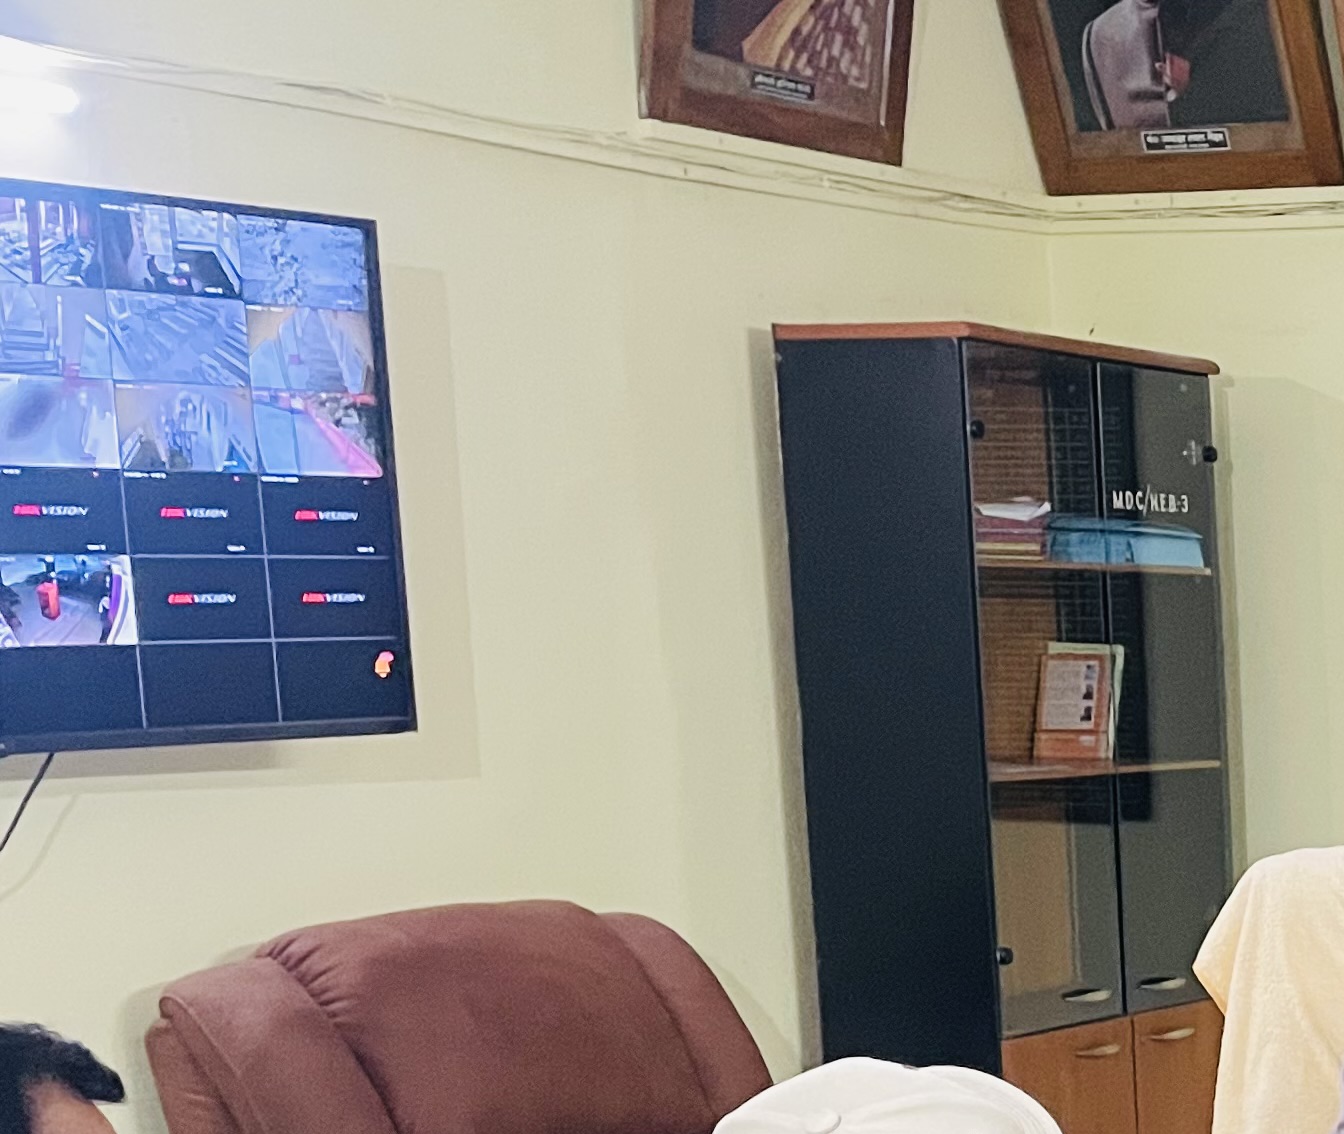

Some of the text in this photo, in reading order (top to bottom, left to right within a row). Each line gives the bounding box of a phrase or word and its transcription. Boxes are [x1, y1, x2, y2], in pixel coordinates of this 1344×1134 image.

[12, 504, 88, 517] VISION
[160, 506, 228, 519] VISION
[294, 509, 359, 522] VISION
[168, 593, 236, 605] VISION
[302, 591, 365, 604] VISION
